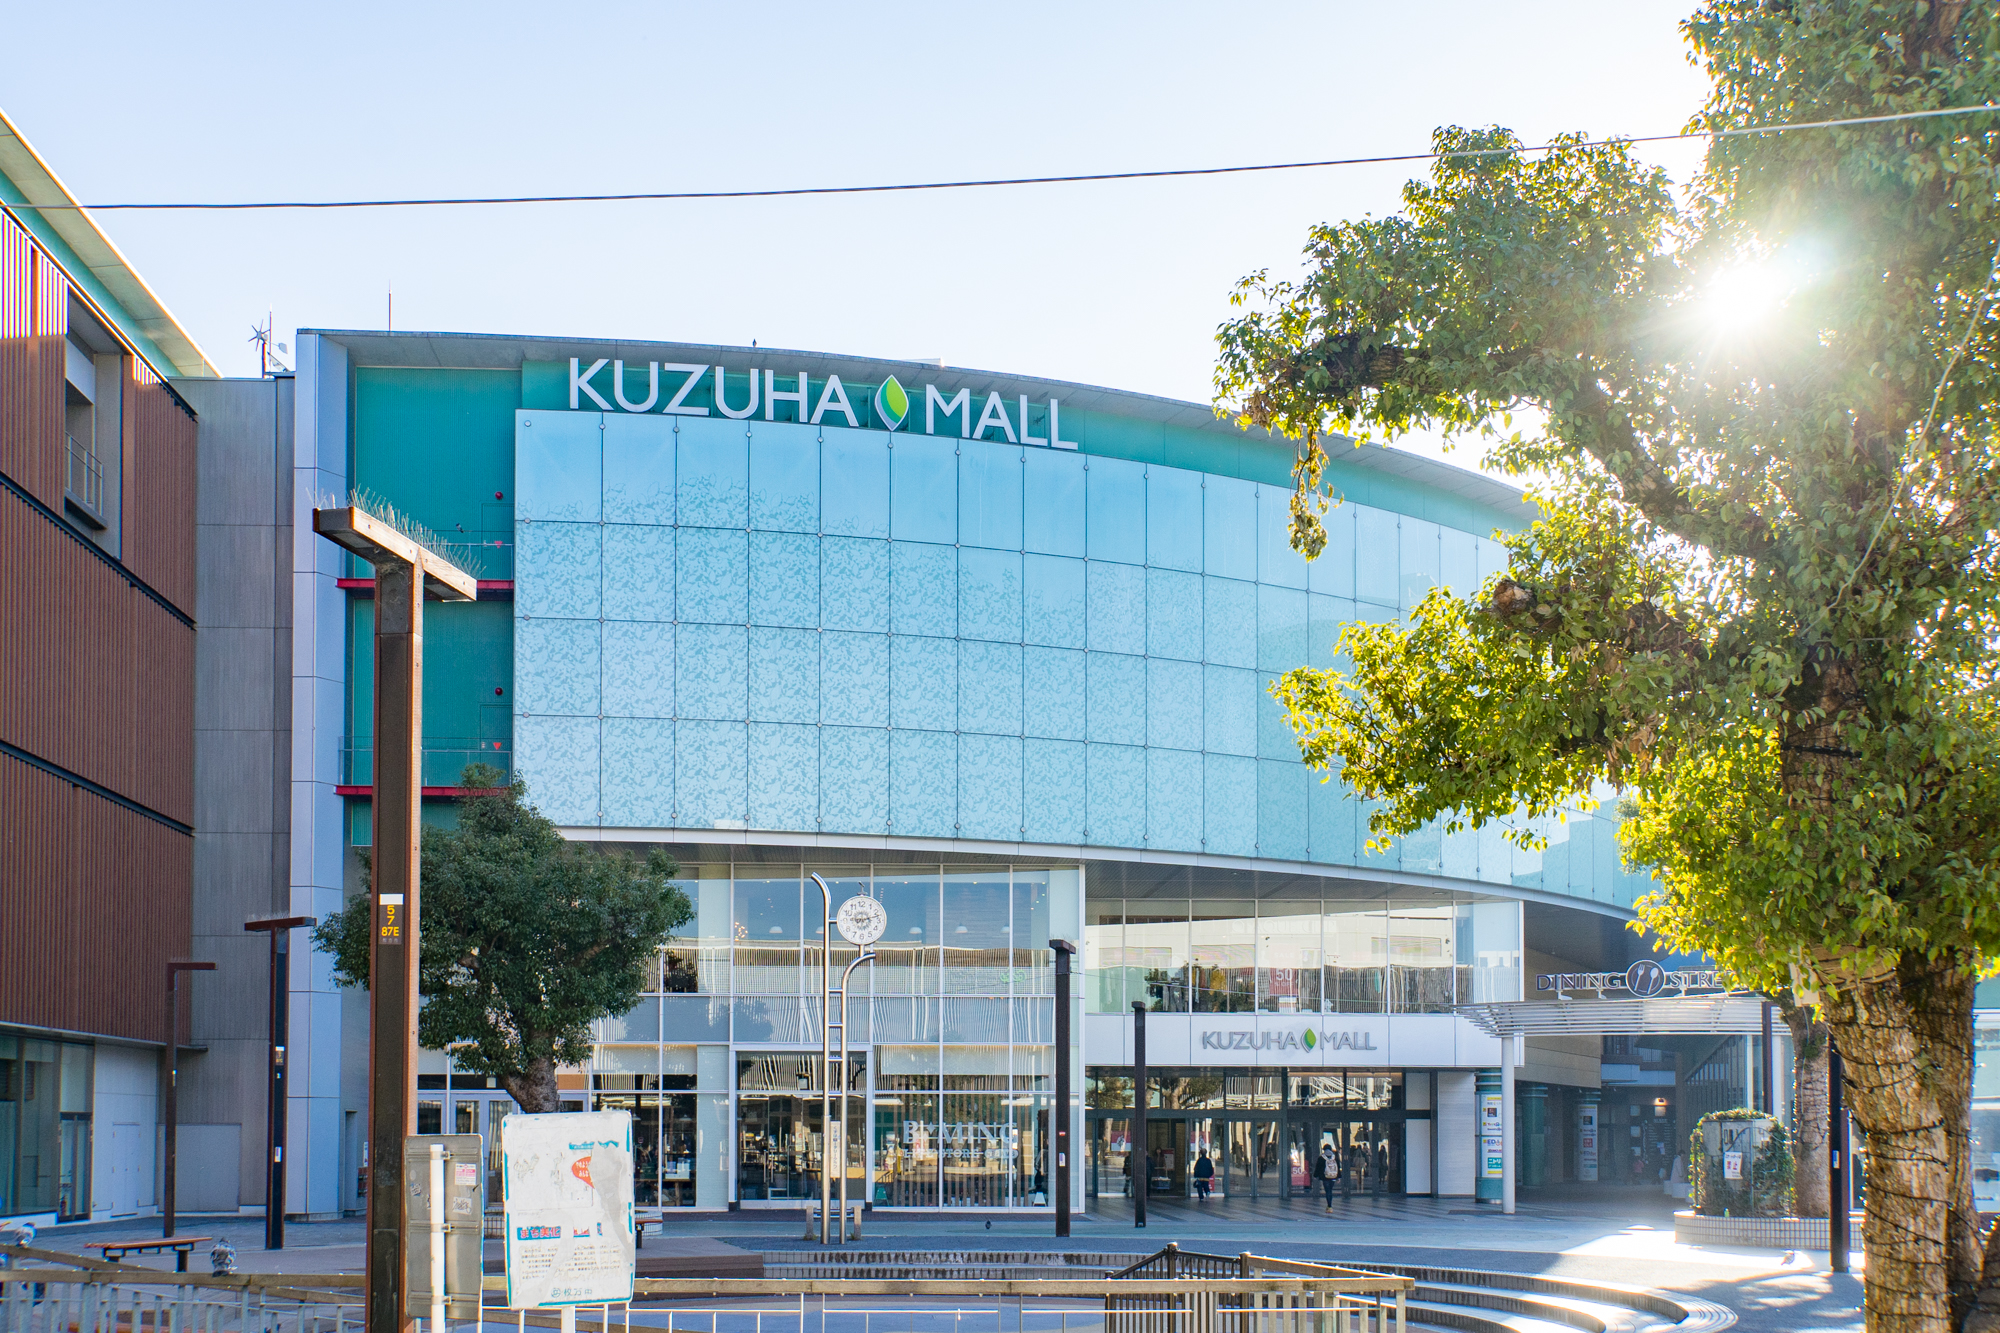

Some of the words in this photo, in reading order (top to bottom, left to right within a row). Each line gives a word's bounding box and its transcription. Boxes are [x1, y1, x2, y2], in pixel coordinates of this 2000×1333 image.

[569, 357, 860, 427] KUZUHA
[925, 383, 1079, 450] MALL
[386, 904, 395, 915] 5
[386, 915, 395, 926] 7
[381, 926, 400, 937] 87E
[1276, 967, 1293, 981] 50
[1535, 972, 1622, 991] DINING
[1669, 970, 1734, 990] STRE
[1202, 1031, 1300, 1050] KUZUHA
[1319, 1031, 1377, 1051] MALL
